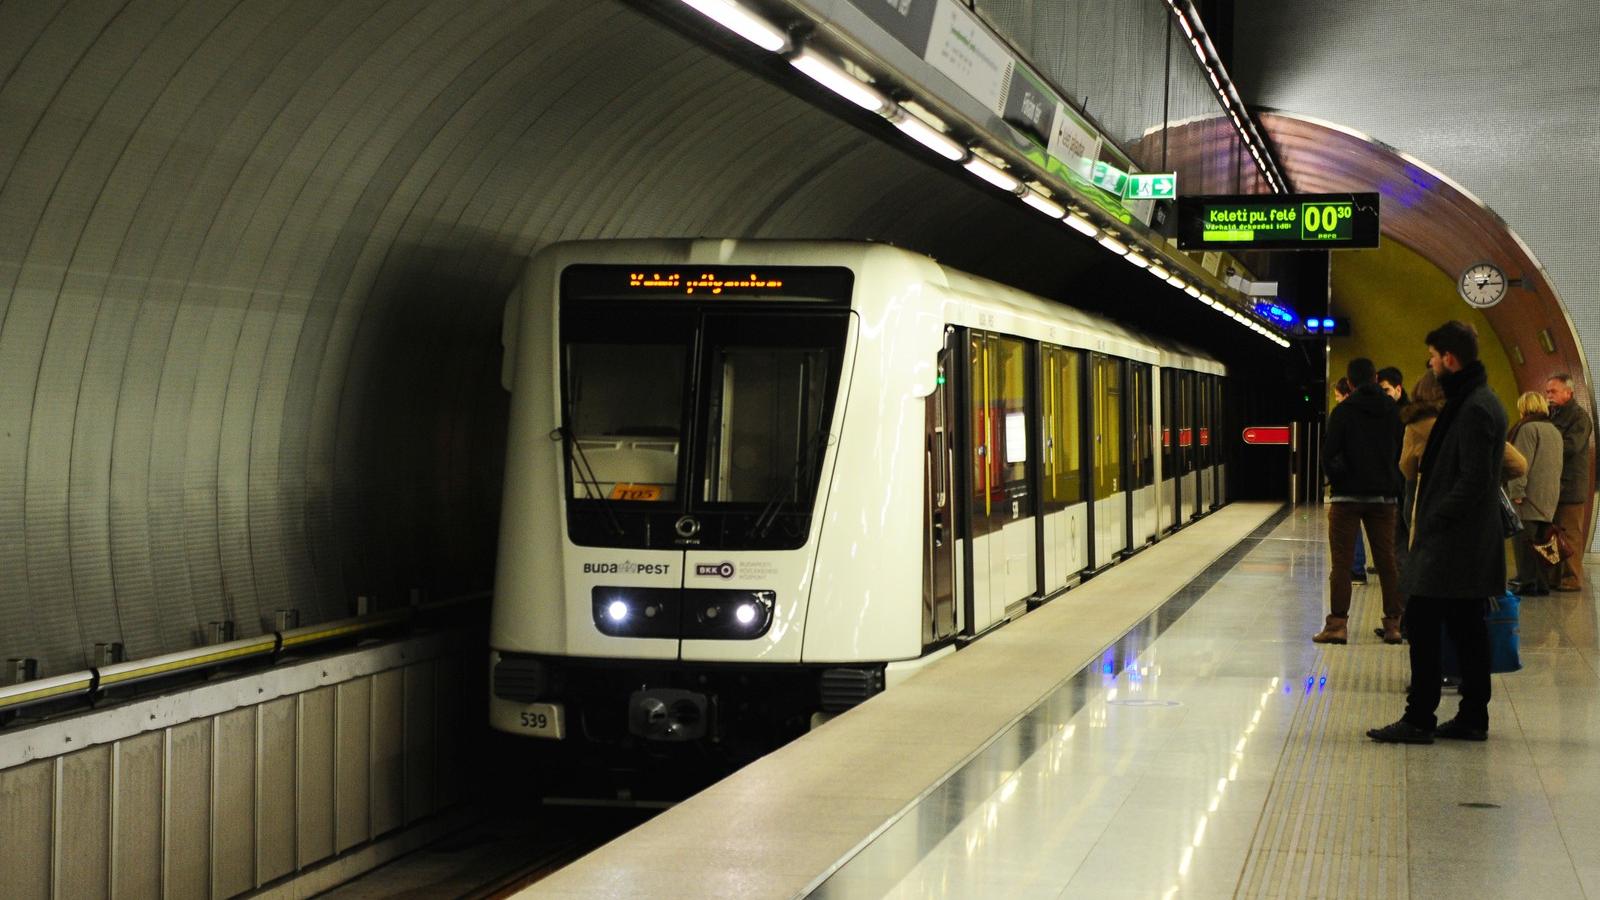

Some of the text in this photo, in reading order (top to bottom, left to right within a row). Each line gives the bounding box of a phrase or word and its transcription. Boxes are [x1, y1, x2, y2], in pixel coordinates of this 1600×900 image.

[1210, 208, 1297, 224] Keleti pu. felé
[1304, 206, 1338, 231] 00
[520, 711, 548, 729] 539
